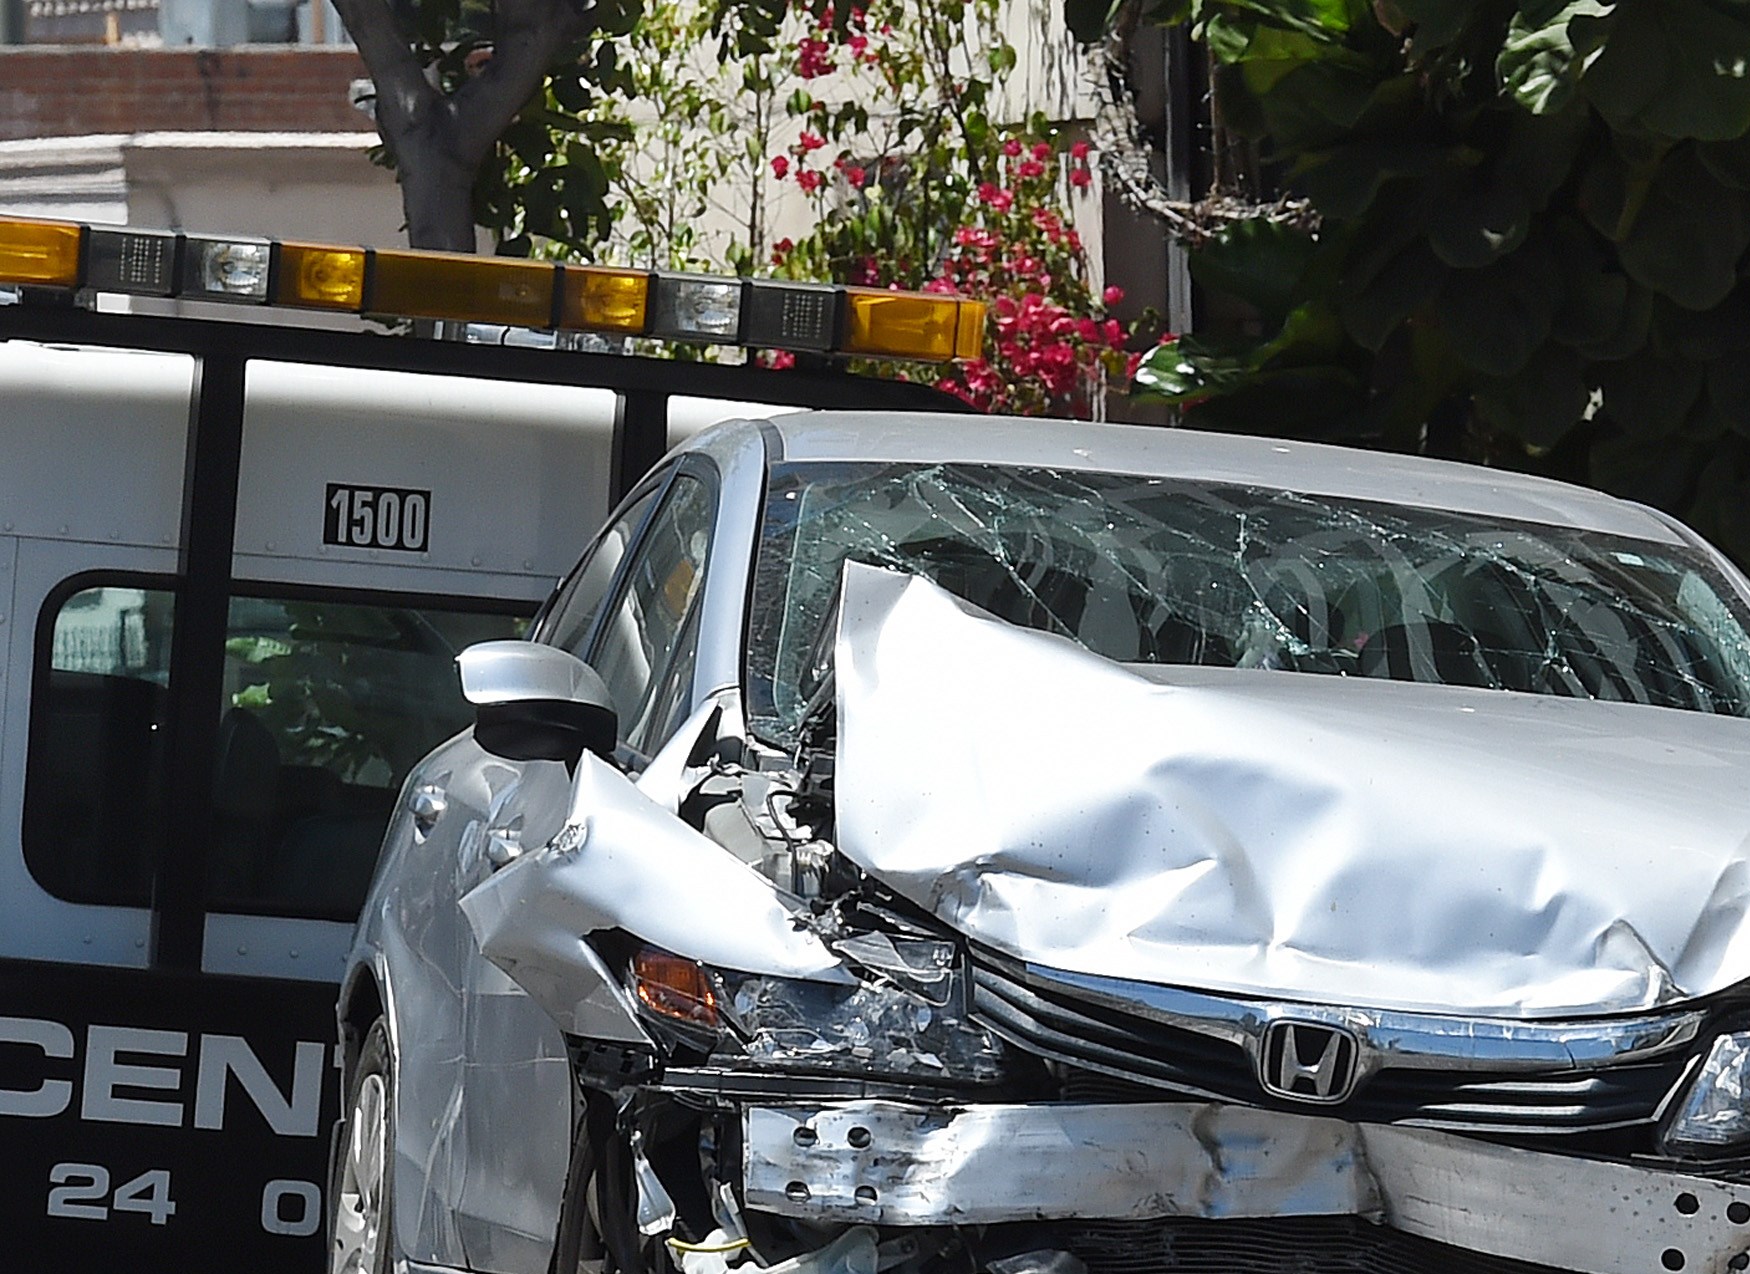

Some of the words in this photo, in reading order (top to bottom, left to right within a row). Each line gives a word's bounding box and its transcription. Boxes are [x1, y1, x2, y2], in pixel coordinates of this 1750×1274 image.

[330, 488, 426, 550] 1500
[0, 1016, 343, 1138] CEN
[46, 1162, 177, 1226] 24
